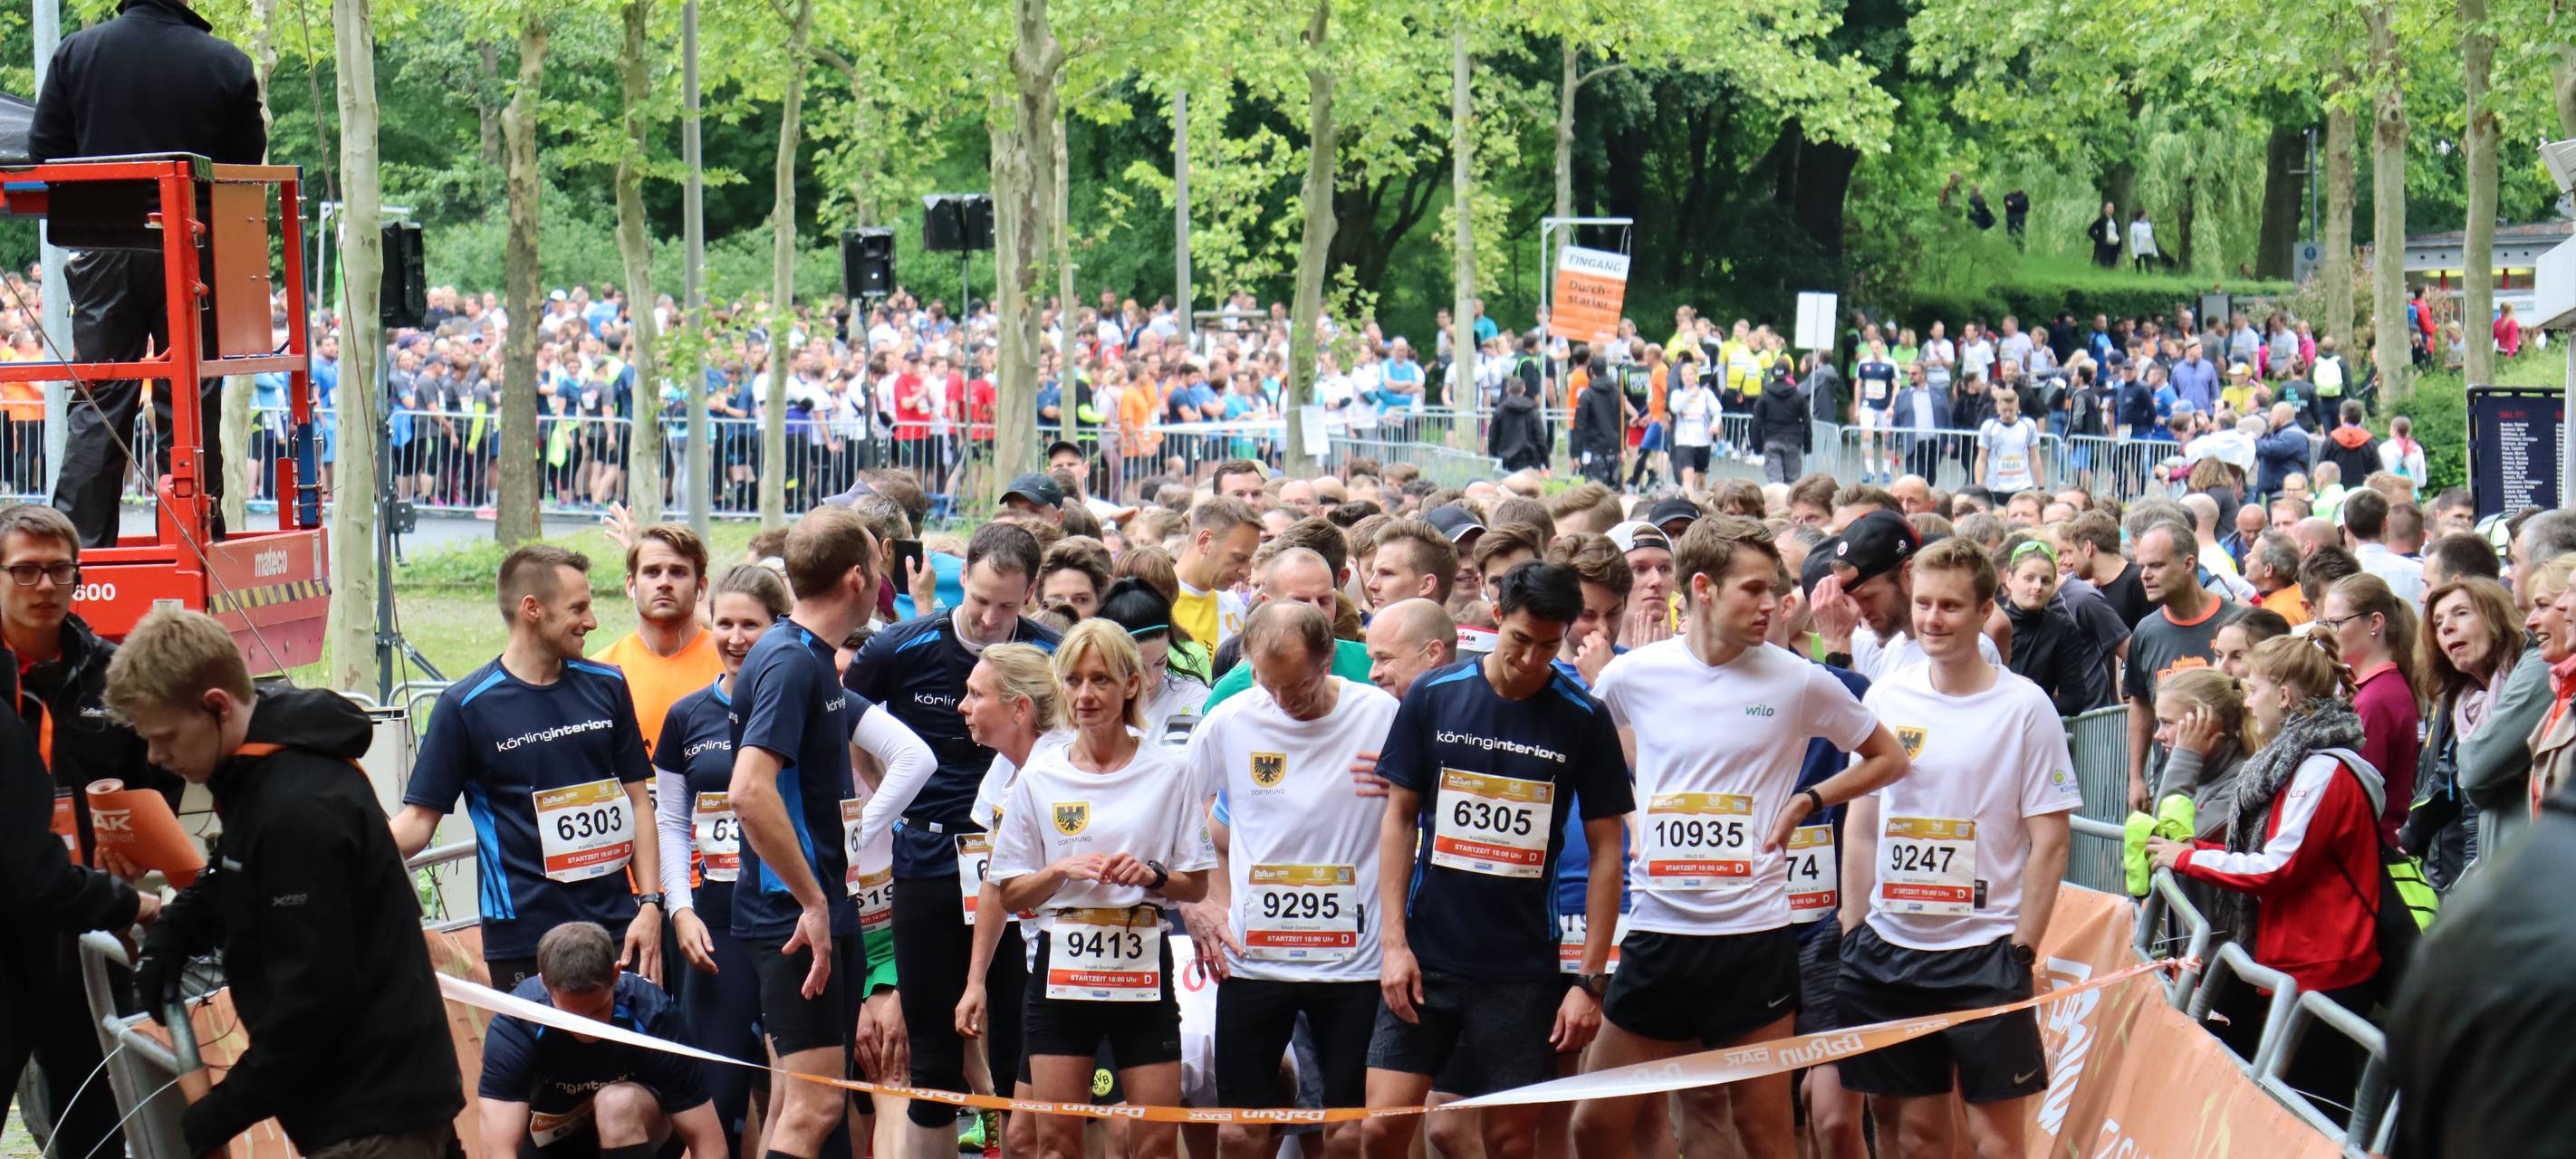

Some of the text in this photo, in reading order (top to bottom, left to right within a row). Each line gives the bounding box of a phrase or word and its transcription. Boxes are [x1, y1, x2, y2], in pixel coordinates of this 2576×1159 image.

[1568, 254, 1621, 272] EINGANG
[1570, 280, 1611, 296] Durch-
[255, 550, 288, 578] mateco
[1745, 704, 1774, 717] wilo
[92, 815, 131, 830] AK
[557, 806, 622, 841] 6303
[1454, 800, 1532, 836] 6305
[713, 818, 739, 842] 63
[1656, 820, 1744, 848] 10935
[1058, 836, 1092, 846] DORTMUND
[568, 853, 600, 864] STARTZEIT
[625, 844, 630, 853] D
[1455, 844, 1490, 855] STARTZEIT
[1492, 849, 1509, 857] 18:00
[1529, 853, 1537, 861] D
[1891, 845, 1956, 872] 9247
[1735, 864, 1744, 873] D
[1785, 854, 1819, 882] 74
[1823, 894, 1830, 904] D
[1957, 889, 1966, 898] D
[1264, 892, 1339, 919] 9295
[1068, 932, 1143, 959] 9413
[1341, 934, 1349, 943] D
[1071, 974, 1106, 982] STARTZEIT
[1144, 974, 1152, 984] D
